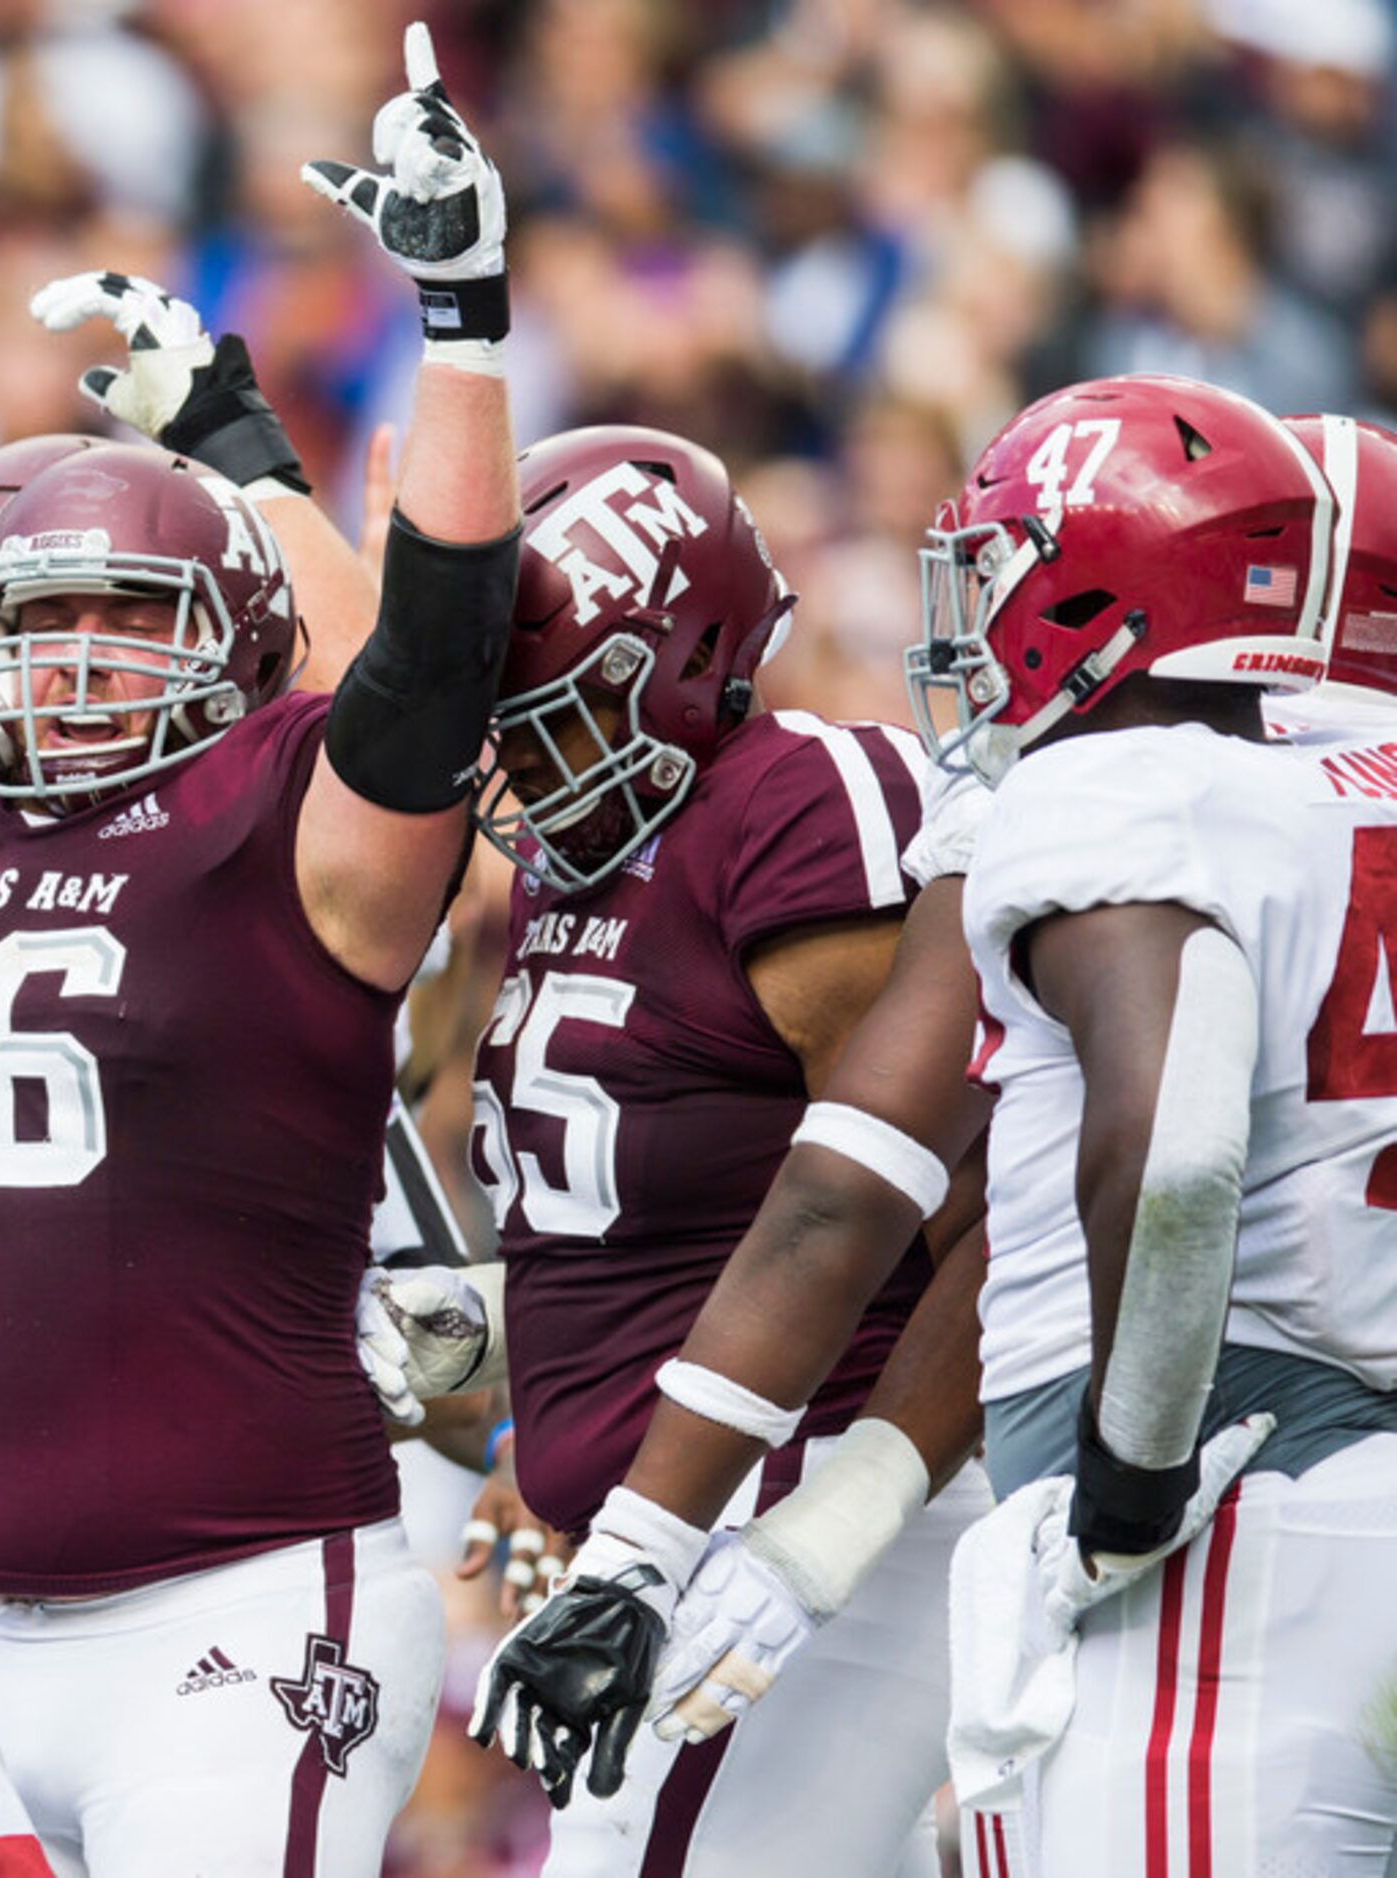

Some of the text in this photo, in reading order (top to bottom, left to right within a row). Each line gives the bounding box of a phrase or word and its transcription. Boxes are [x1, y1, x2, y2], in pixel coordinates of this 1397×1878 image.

[1025, 418, 1122, 509] 47
[29, 533, 85, 551] AGGIES
[98, 812, 169, 839] adidas
[26, 870, 129, 915] A&M
[469, 969, 637, 1238] 65
[176, 1669, 257, 1697] adidas
